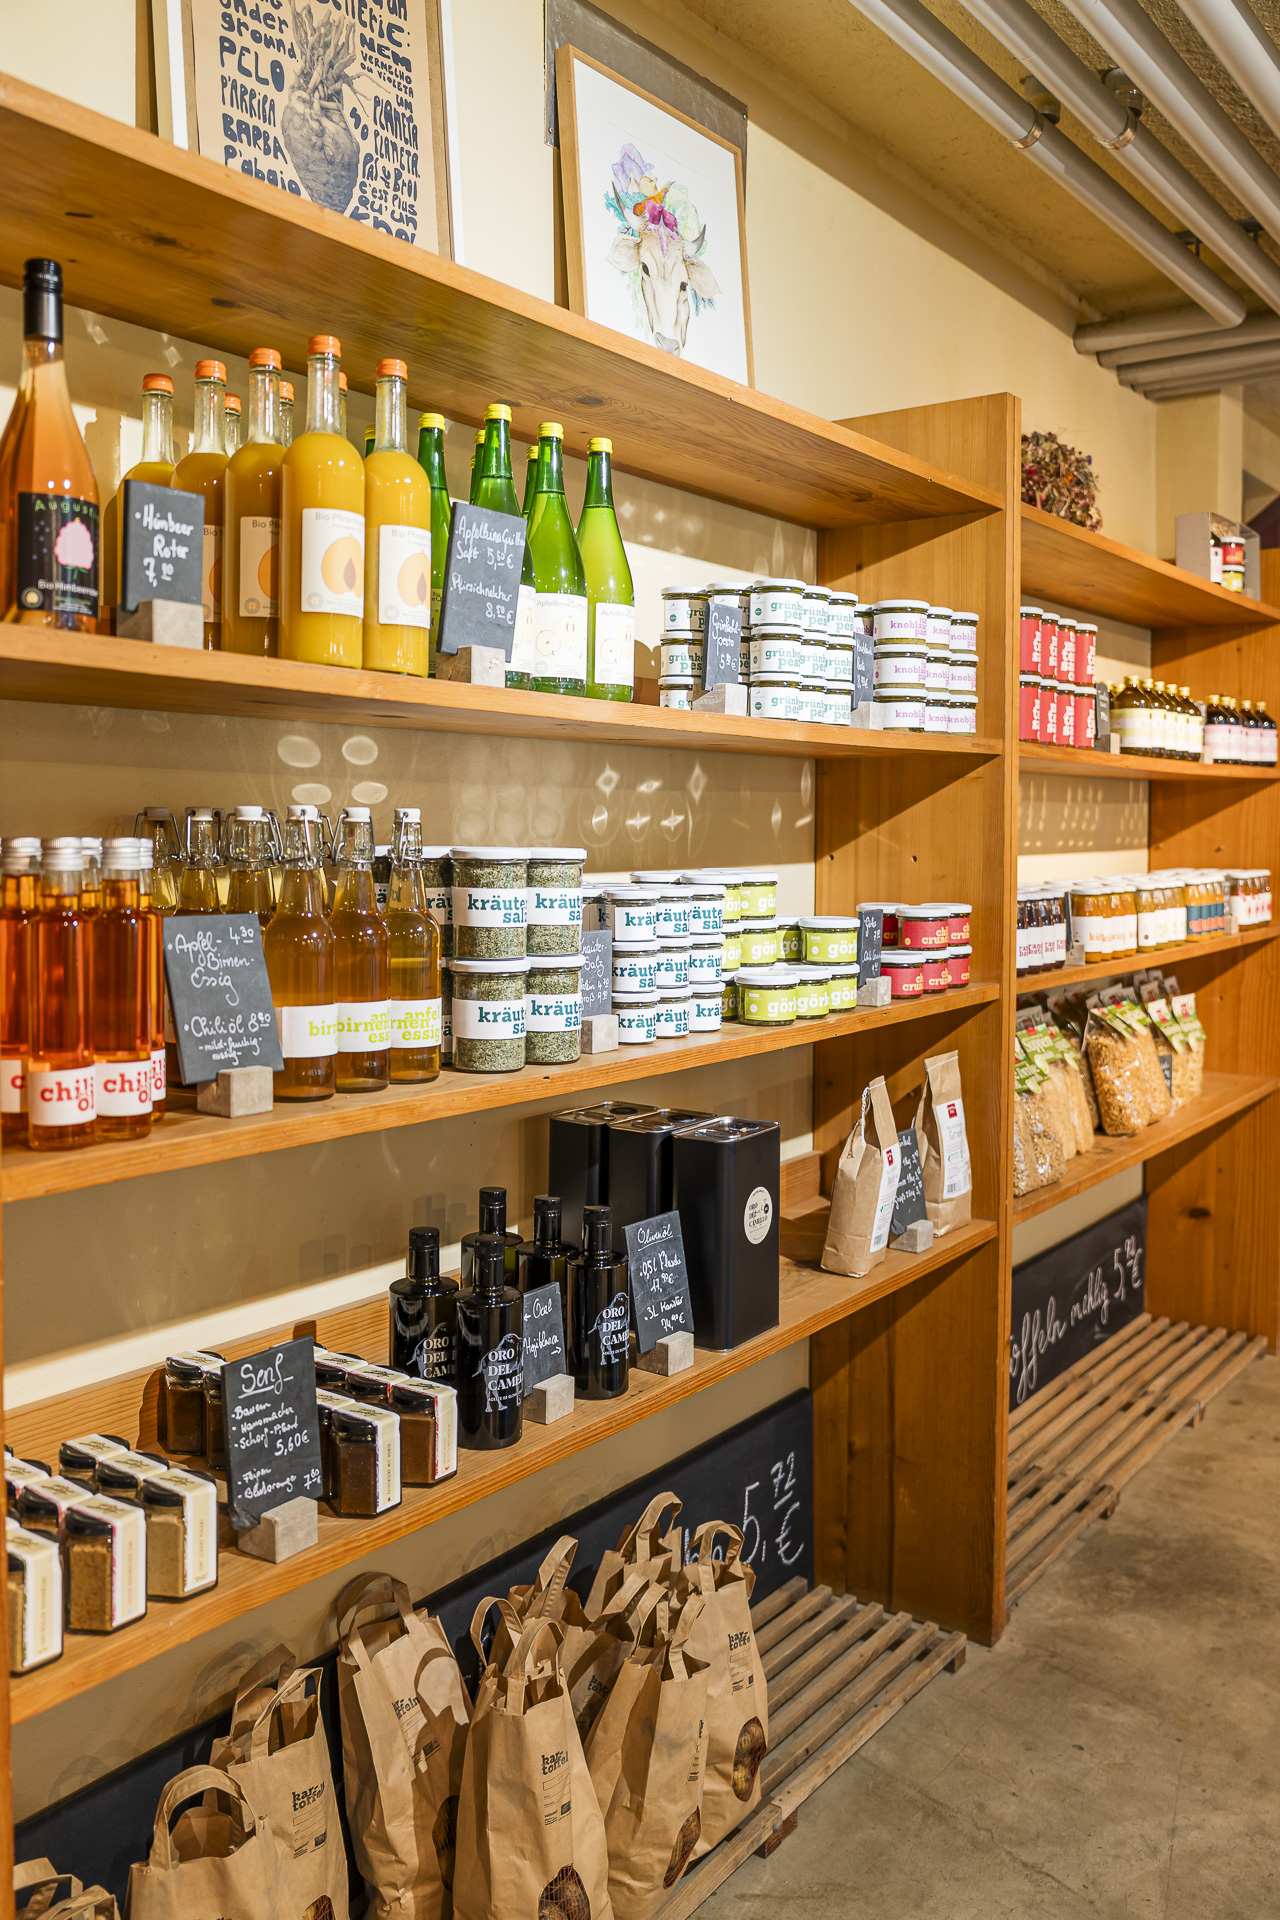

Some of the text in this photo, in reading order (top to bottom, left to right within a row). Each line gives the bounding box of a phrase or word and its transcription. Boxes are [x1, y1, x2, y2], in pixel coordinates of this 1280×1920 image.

[360, 33, 412, 72] NEM
[219, 36, 285, 92] PELO
[360, 50, 412, 85] VERMELHO
[373, 95, 418, 150] PLANETA
[222, 113, 288, 164] BARBA
[315, 511, 330, 522] Bio
[252, 519, 266, 529] Bio
[392, 528, 406, 538] Bio
[190, 966, 239, 1006] Essig
[402, 1025, 440, 1042] essig
[602, 1305, 625, 1319] ORO
[602, 1319, 623, 1333] DEL
[423, 1336, 450, 1350] ORO
[423, 1351, 448, 1364] DEL
[488, 1348, 515, 1362] ORO
[488, 1363, 512, 1377] DEL
